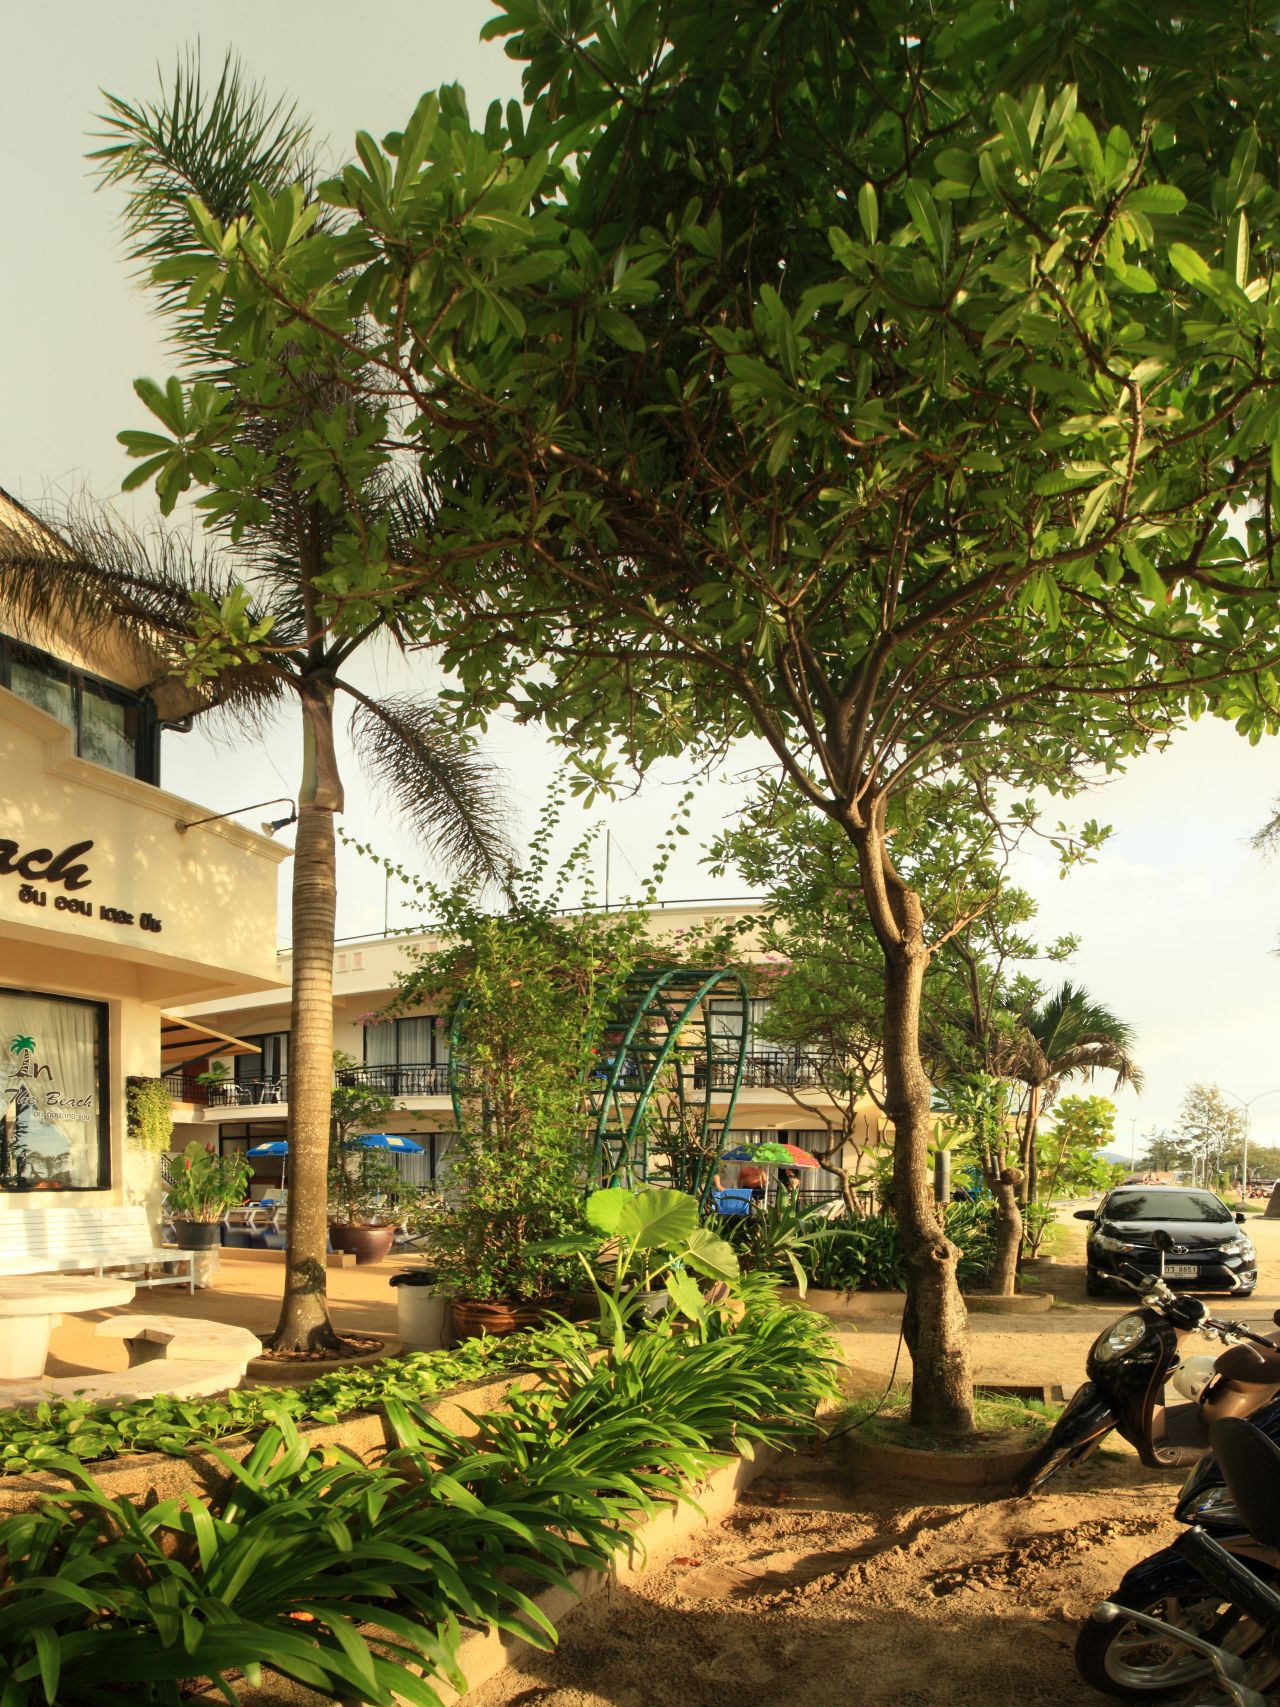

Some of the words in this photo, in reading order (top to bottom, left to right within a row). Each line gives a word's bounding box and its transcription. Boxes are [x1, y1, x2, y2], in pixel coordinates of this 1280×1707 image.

[54, 896, 92, 917] ออน
[4, 1088, 36, 1105] The
[45, 1091, 93, 1108] Beach
